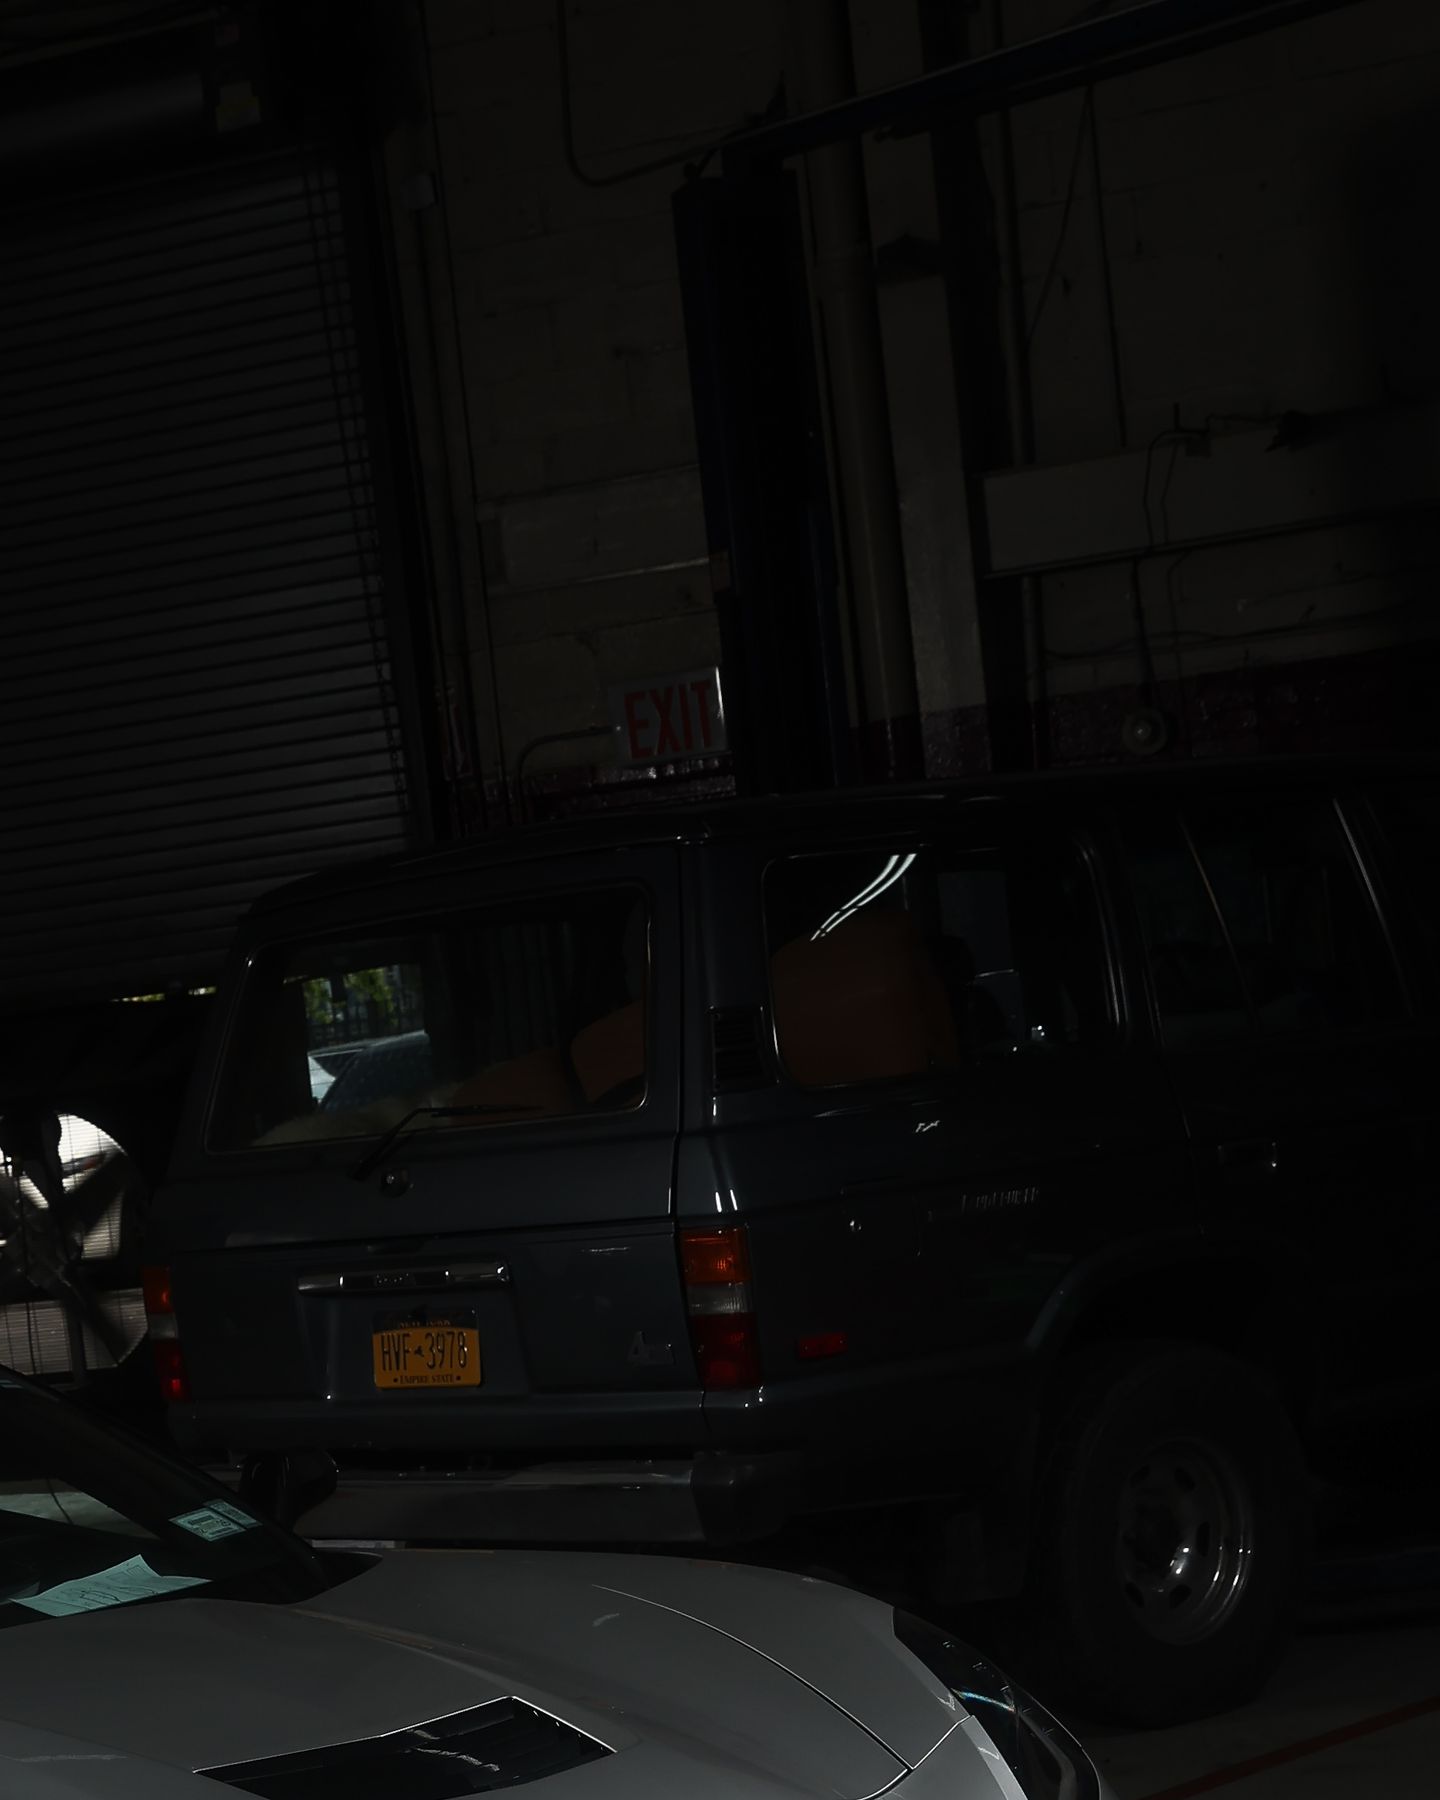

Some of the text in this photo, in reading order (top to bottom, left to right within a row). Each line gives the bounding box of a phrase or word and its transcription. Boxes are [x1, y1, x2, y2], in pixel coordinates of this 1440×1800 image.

[623, 681, 713, 760] EXIT
[380, 1331, 467, 1371] HVF 3978
